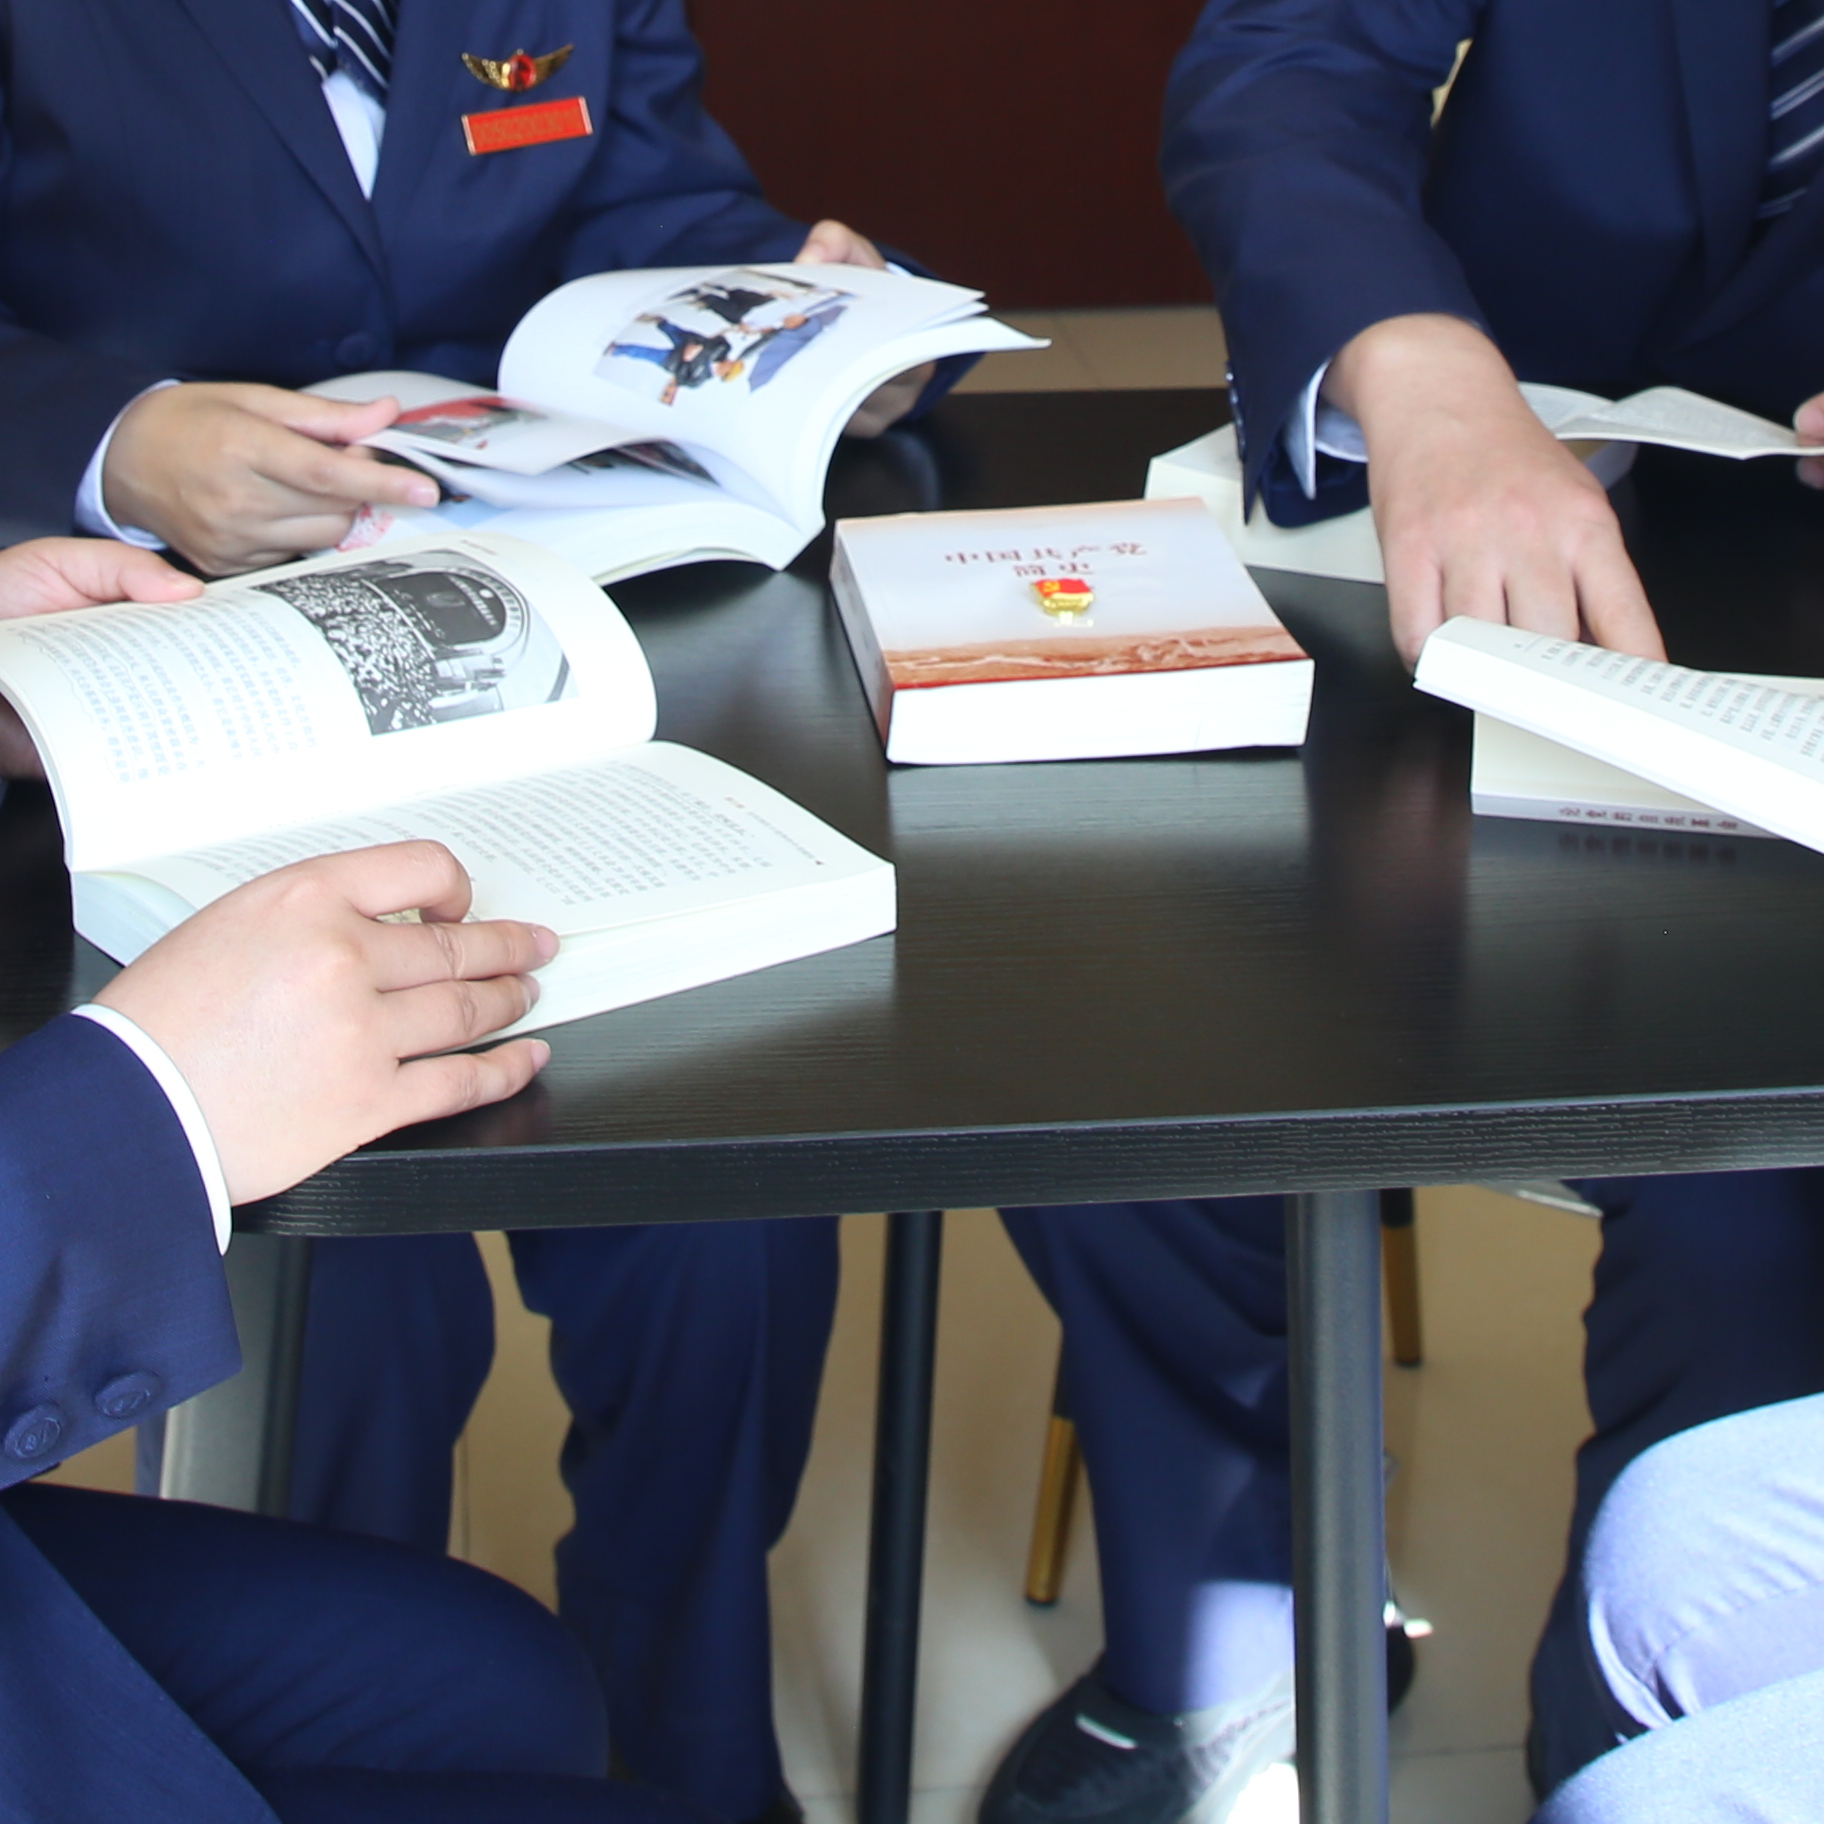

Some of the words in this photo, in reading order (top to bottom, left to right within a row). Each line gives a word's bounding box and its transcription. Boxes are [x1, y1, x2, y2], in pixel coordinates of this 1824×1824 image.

[944, 542, 1147, 564] 中国共产党
[1013, 560, 1095, 578] 简史
